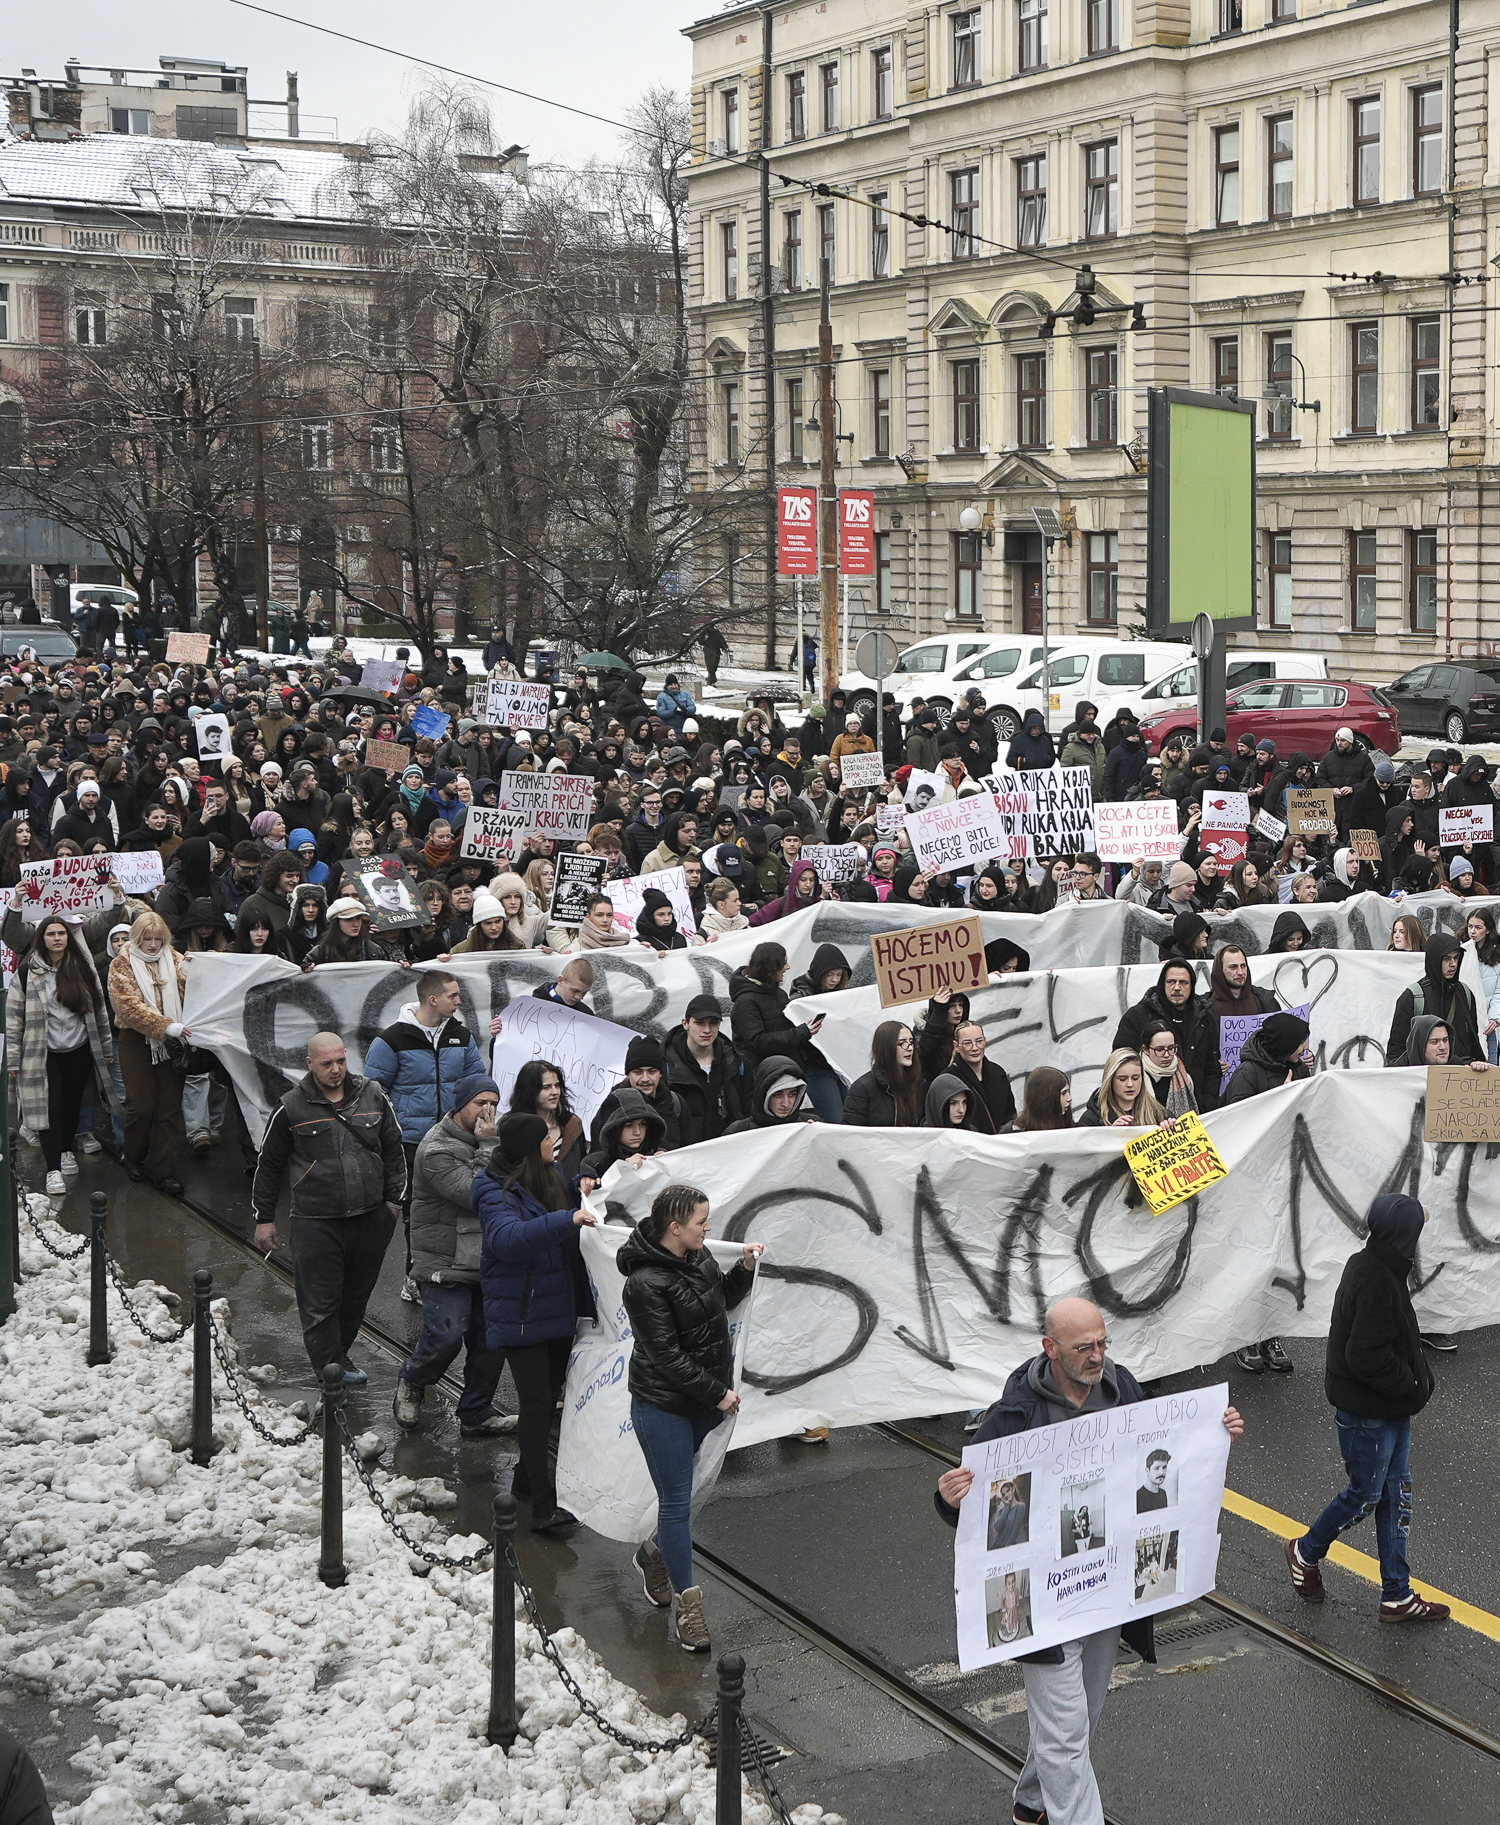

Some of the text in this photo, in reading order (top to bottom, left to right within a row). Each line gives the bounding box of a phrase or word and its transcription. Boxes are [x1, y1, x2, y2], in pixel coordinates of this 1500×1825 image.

[491, 681, 508, 695] IŠLI
[510, 684, 520, 696] BI
[505, 699, 548, 715] VOLIMO
[507, 713, 546, 728] RIKVERC
[505, 773, 552, 790] TRAMVAJ
[844, 772, 861, 780] OTPOR
[984, 768, 1091, 795] BUDI RUKA KOJA
[511, 792, 584, 811] STARA PRIČA
[1035, 787, 1090, 812] HRANI
[1296, 789, 1313, 798] NAŠA
[917, 807, 953, 825] UZELI
[958, 798, 981, 813] STE
[1098, 802, 1171, 822] KOGA ĆETE
[1291, 799, 1327, 809] BUDUĆNOST
[473, 811, 525, 829] DRŽAVA
[535, 811, 565, 829] KRUG
[566, 812, 589, 830] VRTI
[1304, 808, 1328, 818] NIJE NA
[1445, 808, 1473, 820] NEĆEMO
[935, 813, 974, 834] NOVCE
[1022, 810, 1093, 835] RUKA KOJA
[1205, 820, 1216, 828] NE
[1298, 819, 1335, 831] PRODAJU
[483, 825, 514, 838] NAM
[1098, 822, 1179, 840] SLATI U ŠKOLU
[1350, 830, 1371, 841] NAROD
[473, 834, 513, 850] UBIJA
[919, 826, 989, 855] NEĆEMO BITI
[1033, 832, 1085, 856] BRANI
[827, 848, 854, 859] ULICE
[934, 836, 1000, 865] VAŠE OVCE!
[1098, 843, 1119, 855] AKO
[1122, 843, 1142, 855] NAS
[564, 863, 582, 872] LJUDI
[573, 857, 600, 867] MOŽEMO
[830, 858, 856, 870] RUSKI
[51, 895, 94, 915] ŽIVOT
[875, 926, 970, 967] HOĆEMO
[887, 952, 982, 999] ISTINU!
[508, 1001, 577, 1053] NAŠA
[1224, 1019, 1246, 1030] OVO
[1430, 1098, 1458, 1111] SE
[1435, 1112, 1488, 1127] NAROD
[1429, 1129, 1464, 1139] SKIDA
[1471, 1129, 1489, 1139] SA
[1142, 1151, 1217, 1196] A VI PADATE
[1144, 1167, 1158, 1178] MI
[1159, 1158, 1177, 1172] SMO
[723, 1158, 1199, 1395] SMO
[984, 1397, 1198, 1472] MLADOST KOJU JE UBIO
[1136, 1429, 1169, 1445] ERDOAN
[1052, 1442, 1116, 1475] SISTEM
[994, 1464, 1022, 1480] ELLA
[1138, 1524, 1161, 1538] ESMA
[1047, 1572, 1062, 1590] KO
